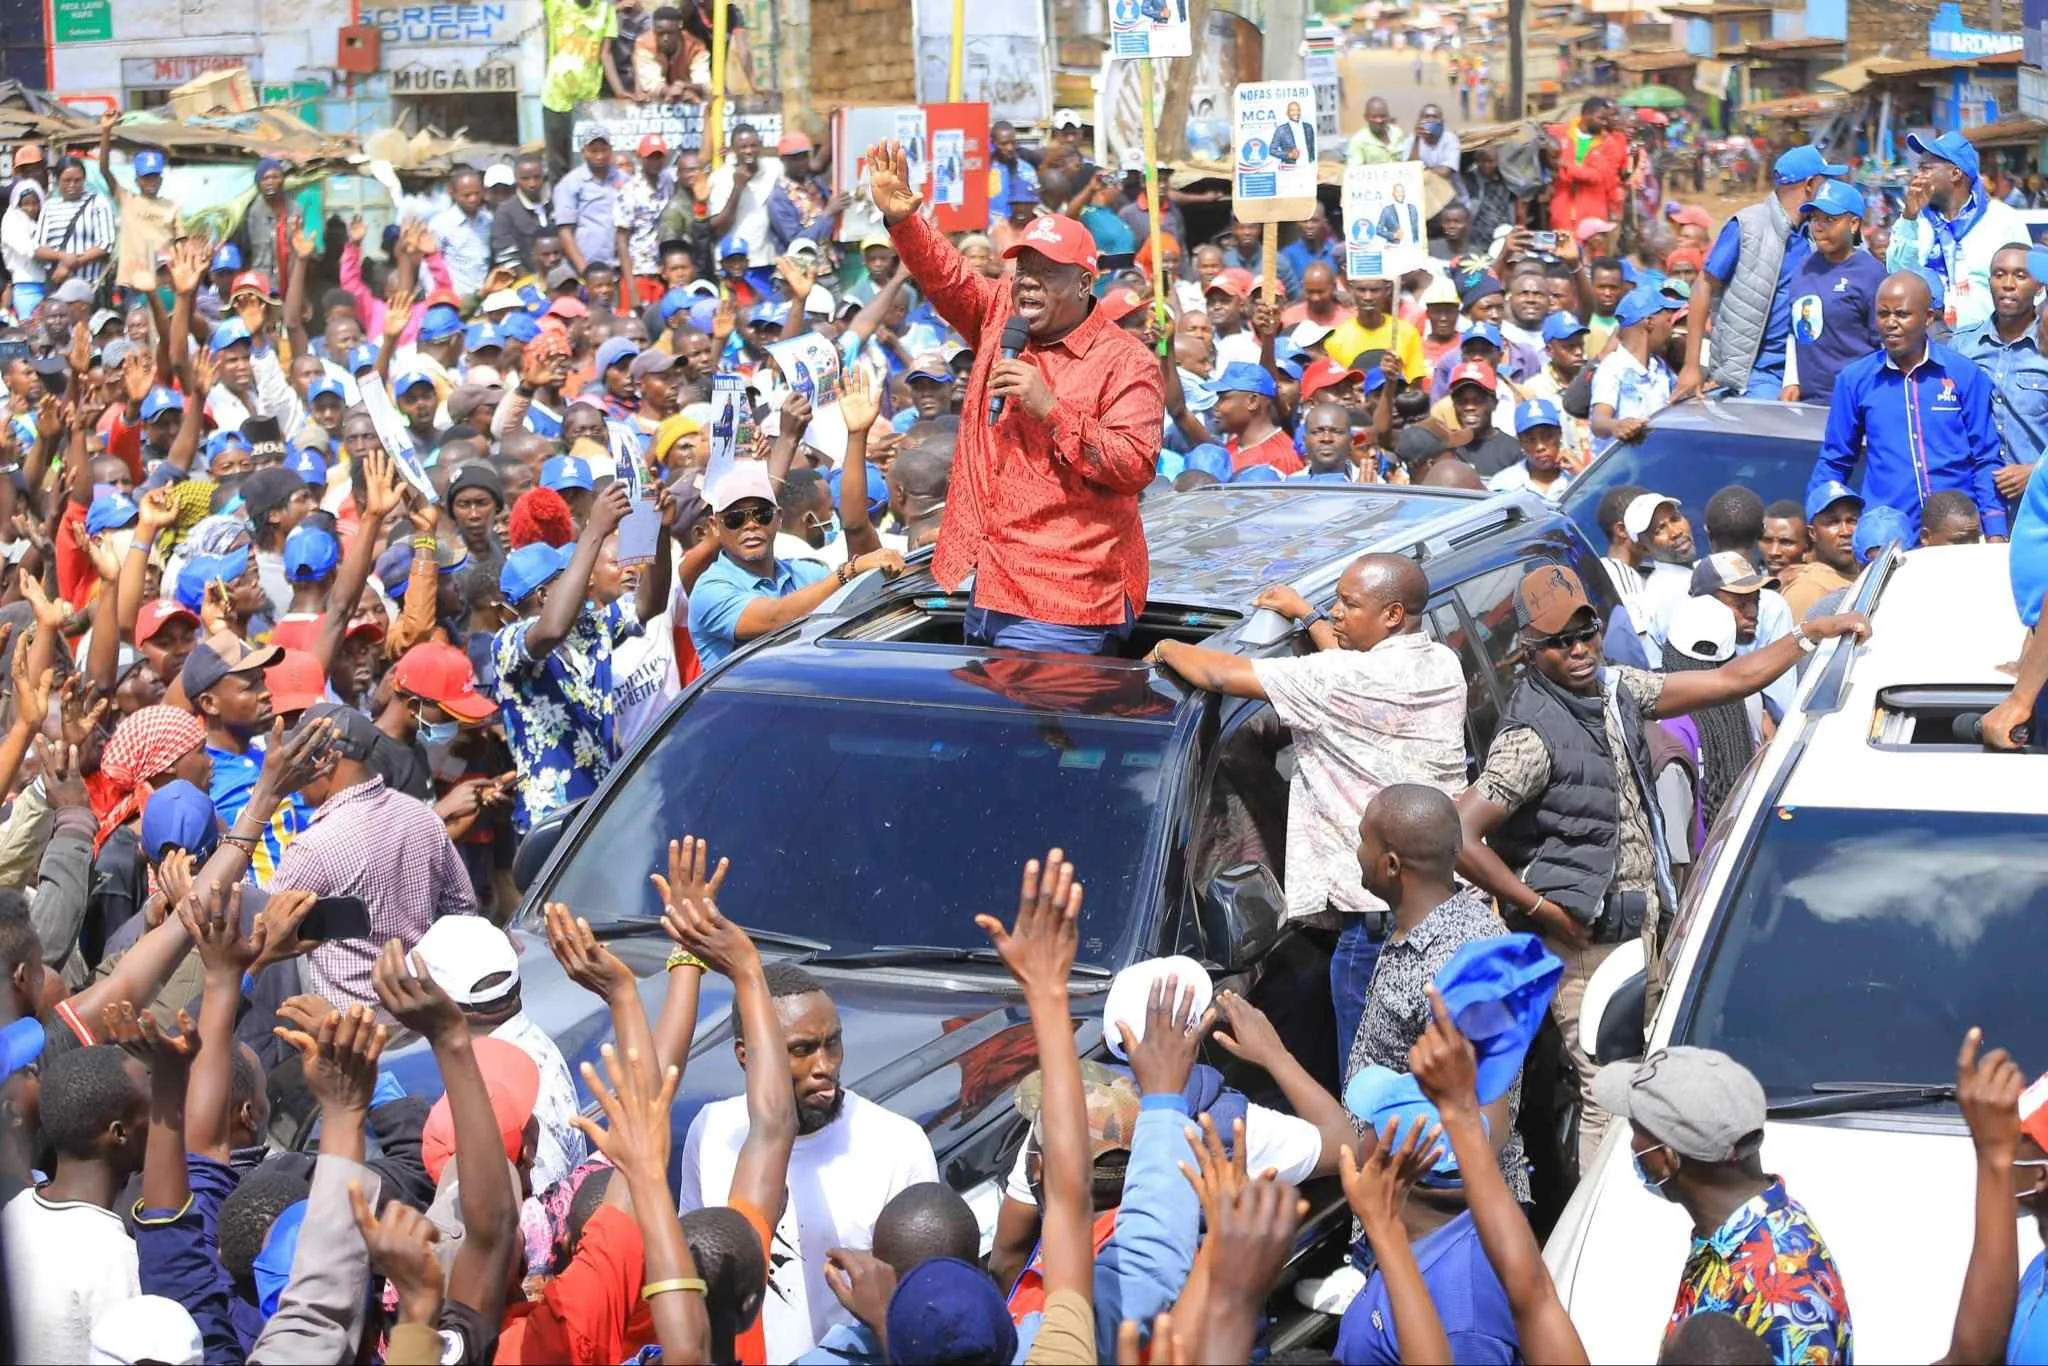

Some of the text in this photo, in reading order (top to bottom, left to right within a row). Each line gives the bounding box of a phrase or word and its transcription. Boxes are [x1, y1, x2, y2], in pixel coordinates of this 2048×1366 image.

[358, 5, 505, 25] SCREEN
[380, 24, 493, 42] OUCH
[393, 64, 517, 89] MUGAMBI
[1242, 109, 1277, 121] MCA
